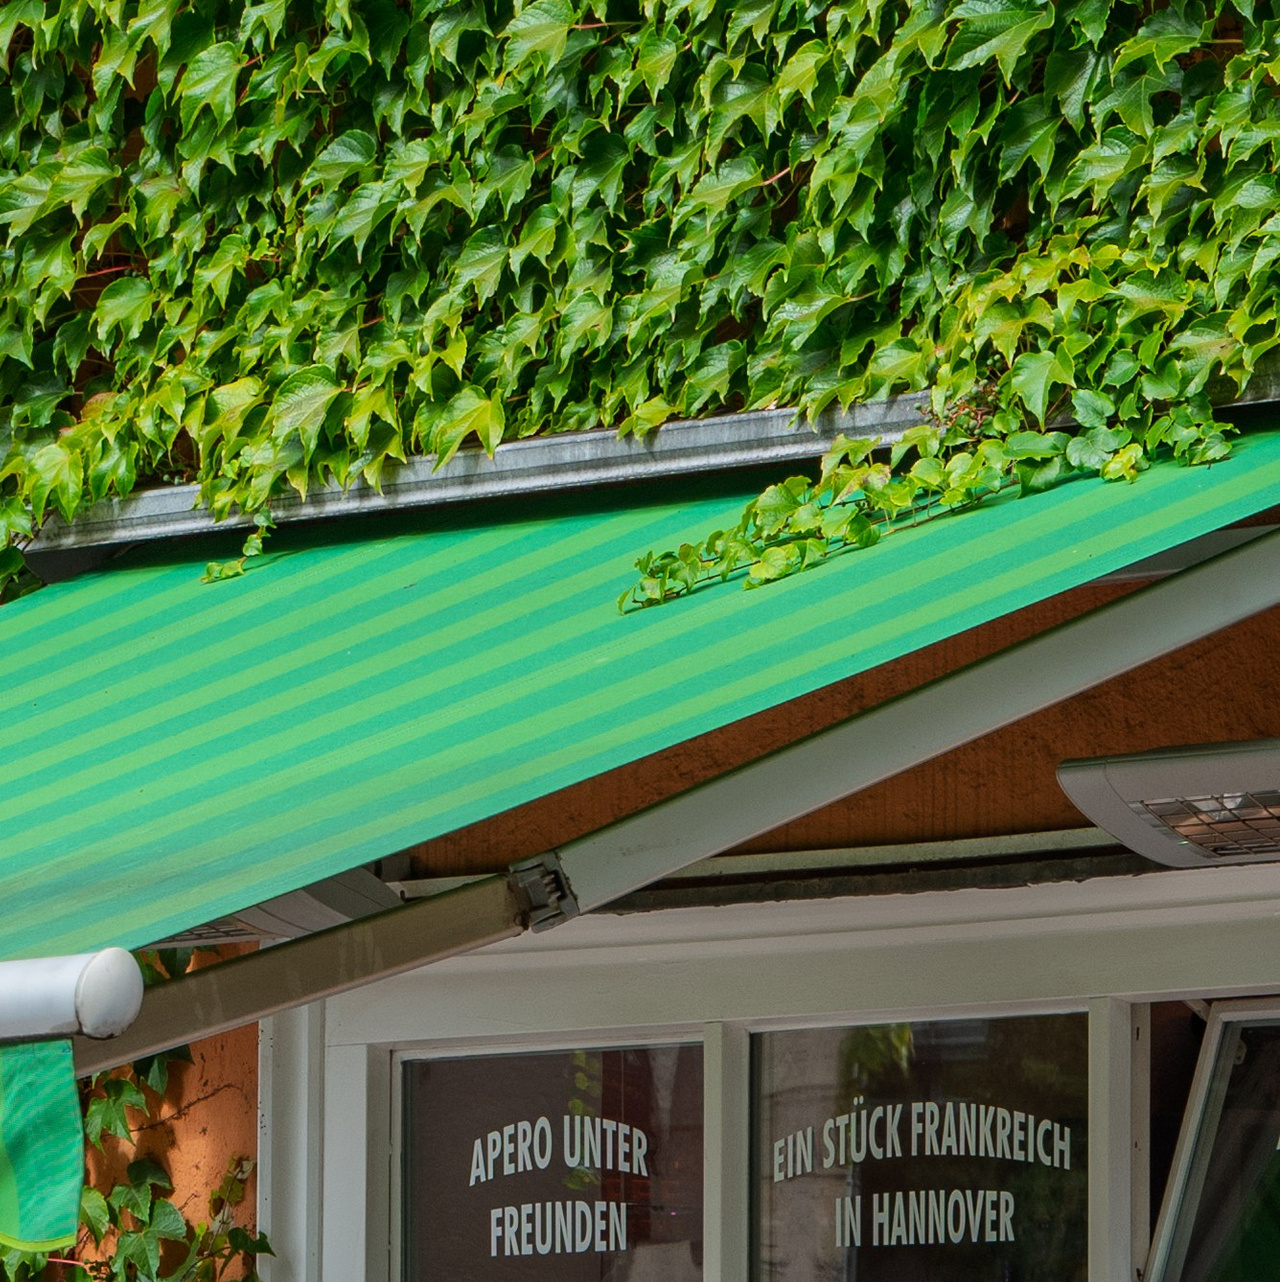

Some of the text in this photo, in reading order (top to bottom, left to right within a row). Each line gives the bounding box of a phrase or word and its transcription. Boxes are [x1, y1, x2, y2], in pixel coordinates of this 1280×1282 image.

[469, 1115, 648, 1187] APERO UNTER
[773, 1095, 1071, 1183] EIN STÜCK FRANKREICH
[490, 1201, 627, 1257] FREUNDEN
[835, 1189, 1015, 1248] IN HANNOVER
